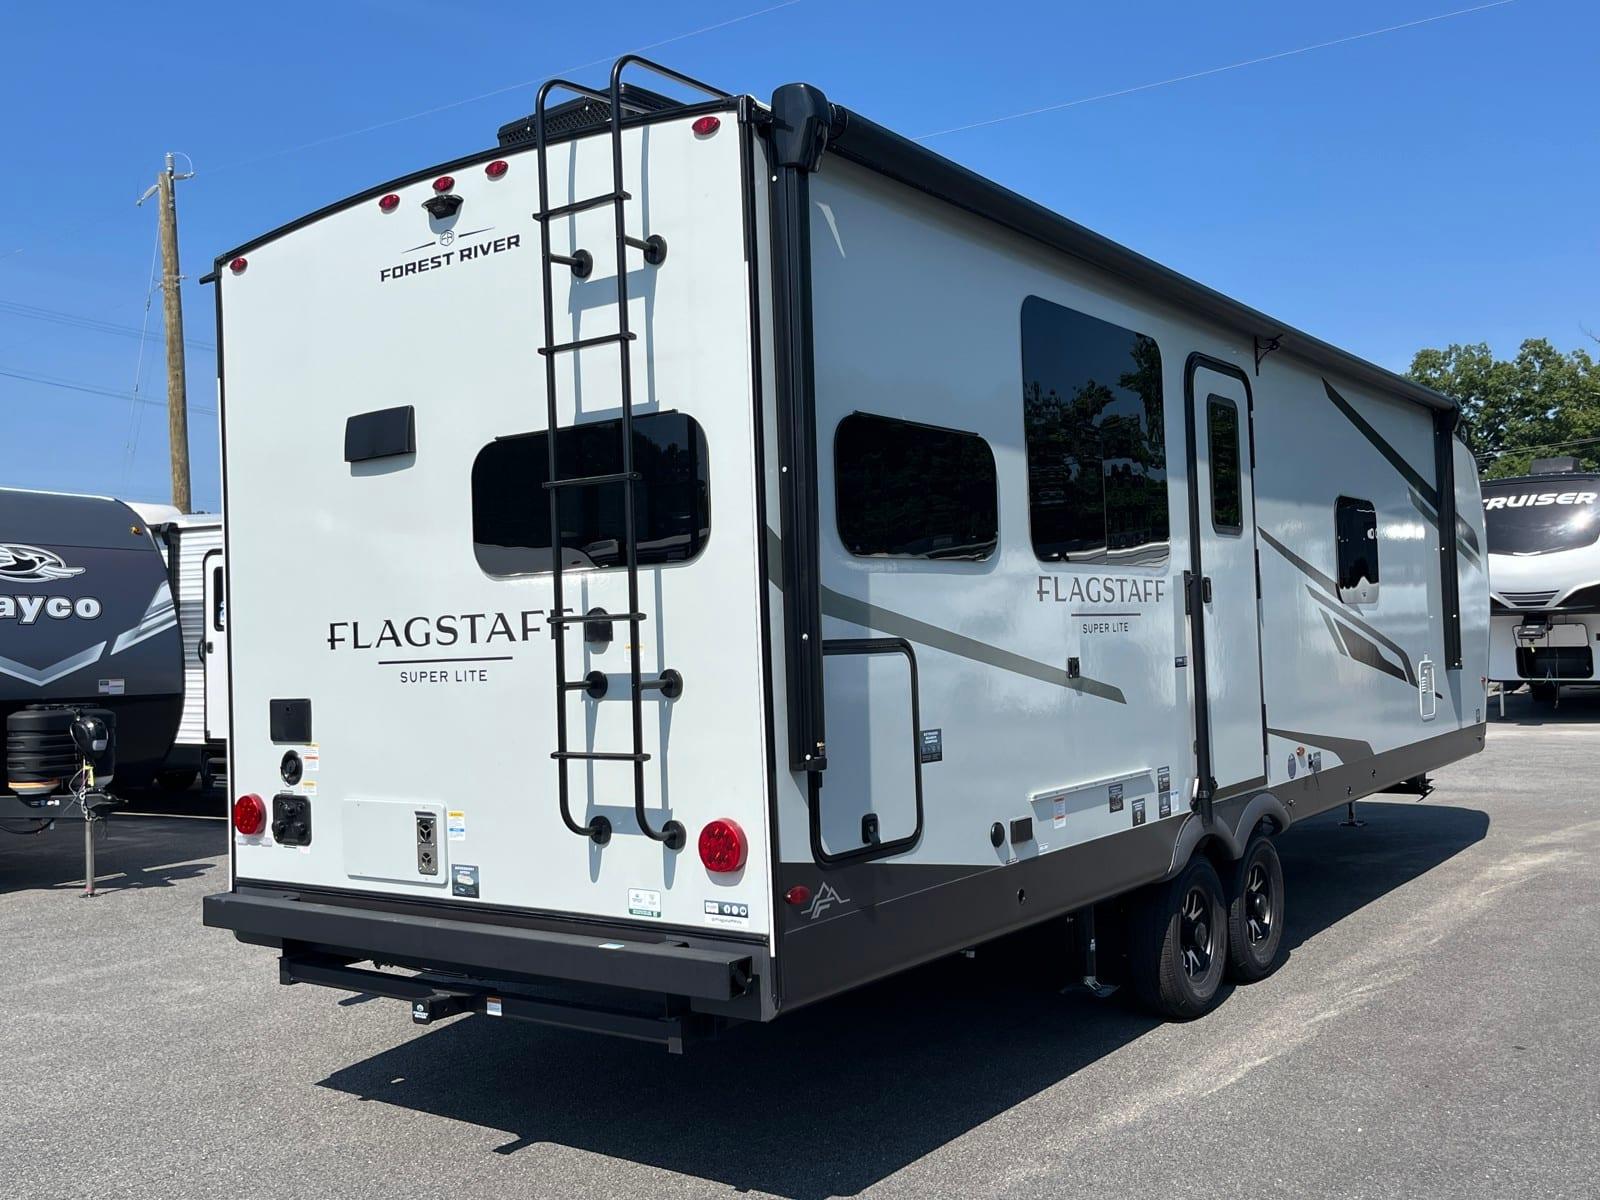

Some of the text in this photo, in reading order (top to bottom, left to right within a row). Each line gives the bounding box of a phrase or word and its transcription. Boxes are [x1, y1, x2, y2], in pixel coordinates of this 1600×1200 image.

[380, 234, 520, 282] FOREST RIVER
[1482, 492, 1598, 510] RUISER
[1036, 576, 1166, 603] FLAGSTAFF
[0, 595, 102, 625] ayco
[1082, 622, 1129, 634] SUPER LITE
[400, 670, 487, 683] SUPER LITE
